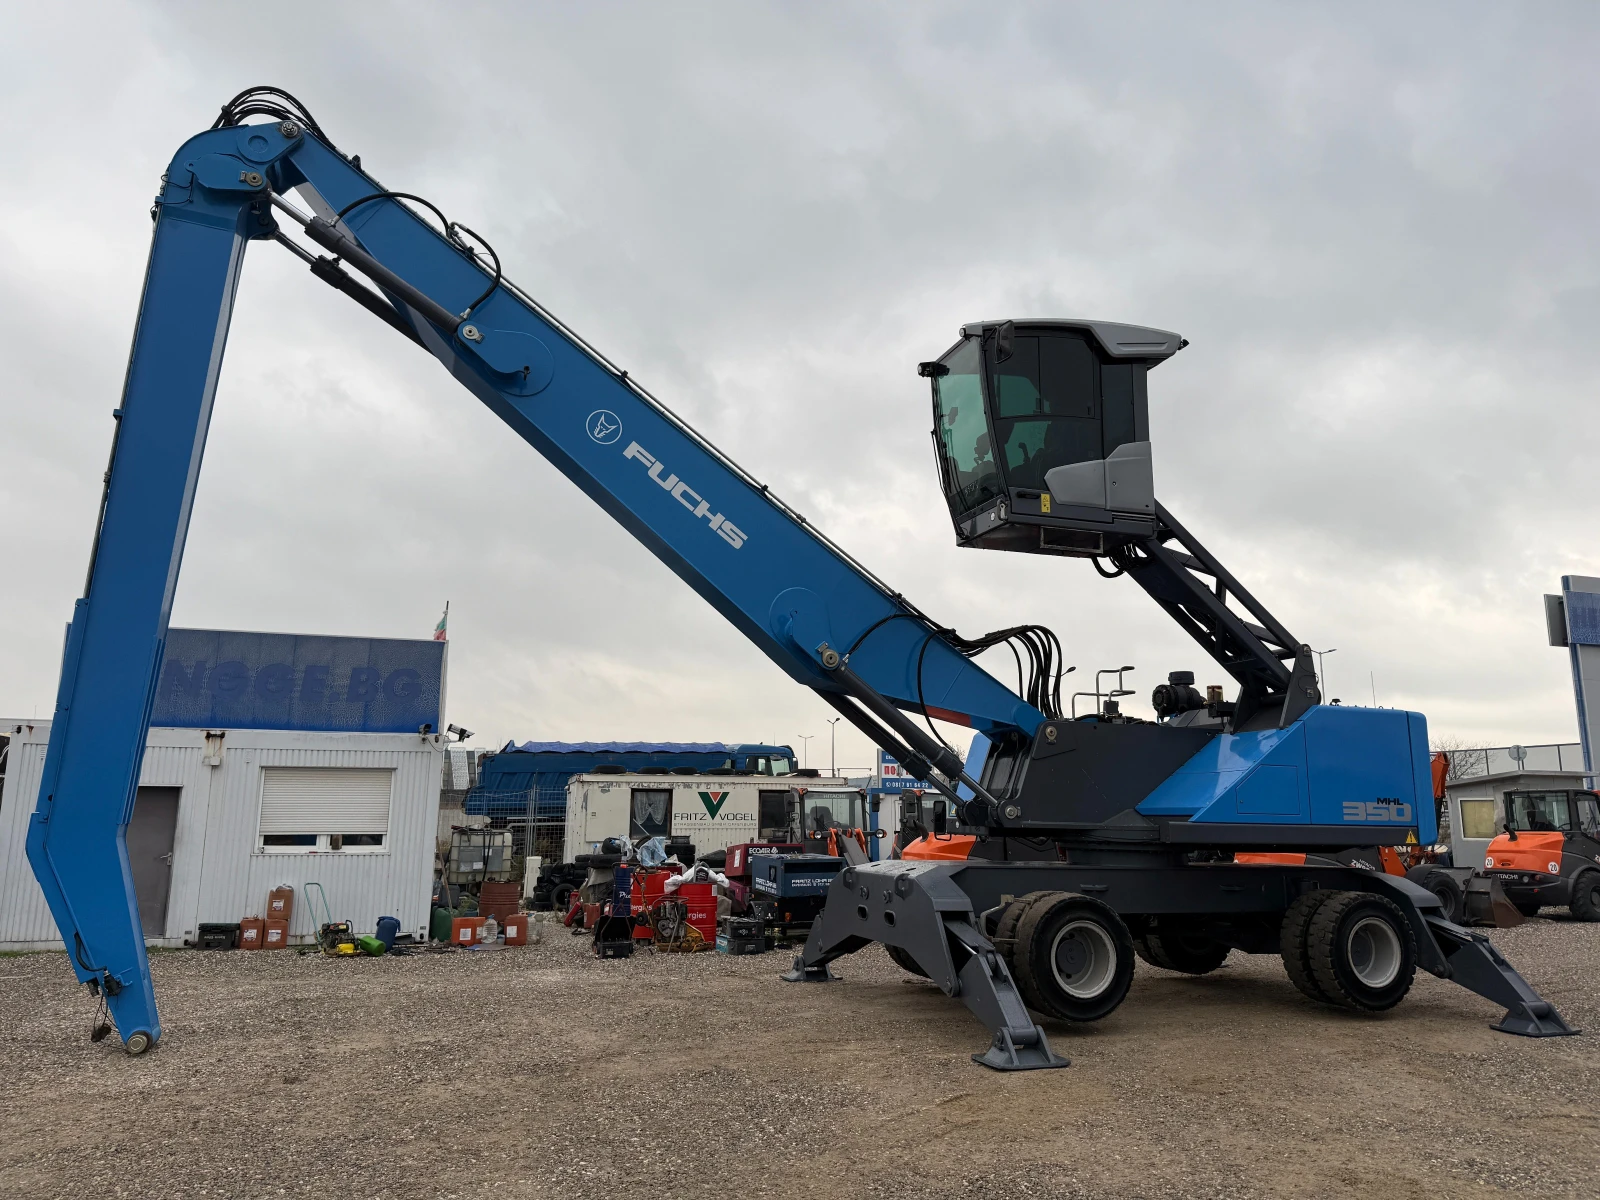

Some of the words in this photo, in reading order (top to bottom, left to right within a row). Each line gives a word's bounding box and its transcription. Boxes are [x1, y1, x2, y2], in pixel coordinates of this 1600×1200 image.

[623, 441, 748, 549] FUCHS
[1376, 797, 1403, 805] MHL
[1342, 801, 1412, 822] 350
[673, 812, 707, 821] FRITZ
[719, 812, 757, 821] VOGEL
[1486, 859, 1493, 867] 20
[1550, 864, 1558, 873] 20
[687, 911, 707, 920] rgies
